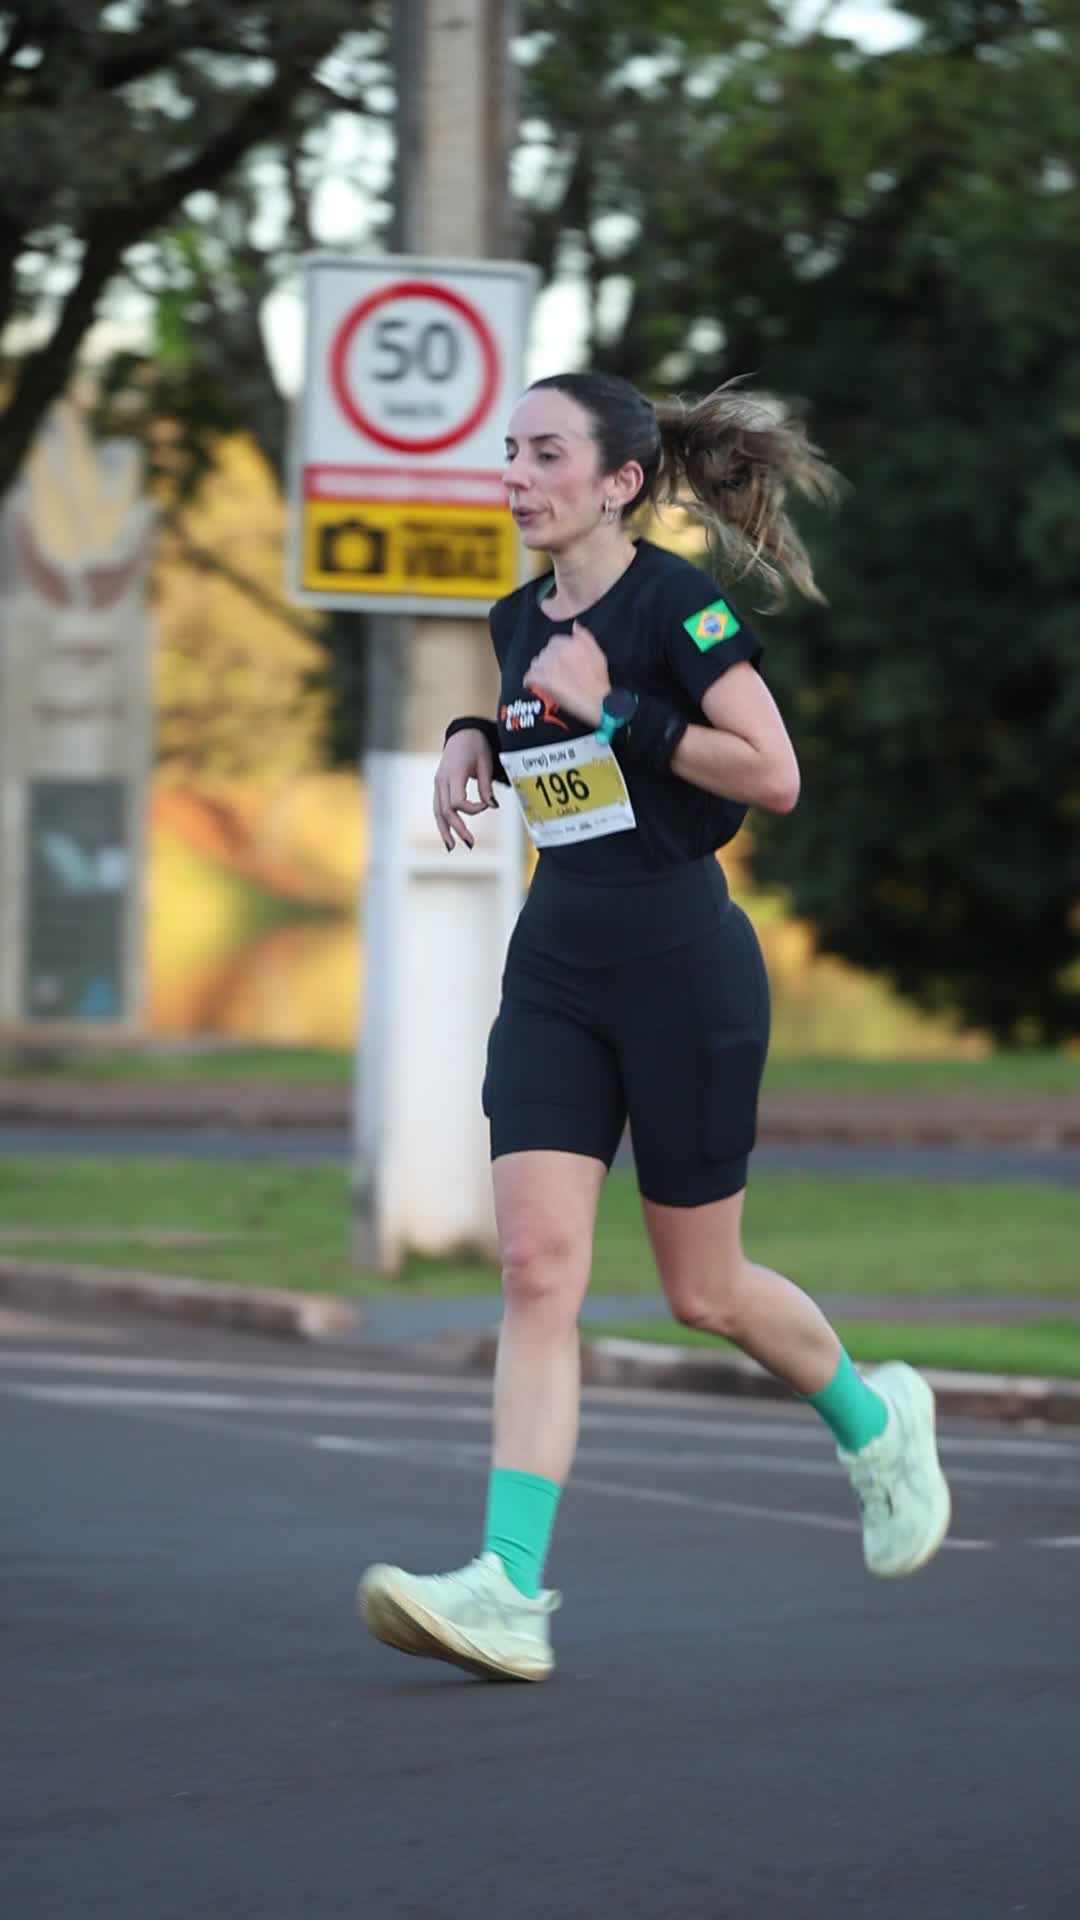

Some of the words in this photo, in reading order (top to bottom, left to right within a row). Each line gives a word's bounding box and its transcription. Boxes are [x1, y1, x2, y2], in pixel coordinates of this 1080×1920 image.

[371, 320, 460, 383] 50
[549, 750, 567, 764] RUN
[535, 768, 590, 808] 196
